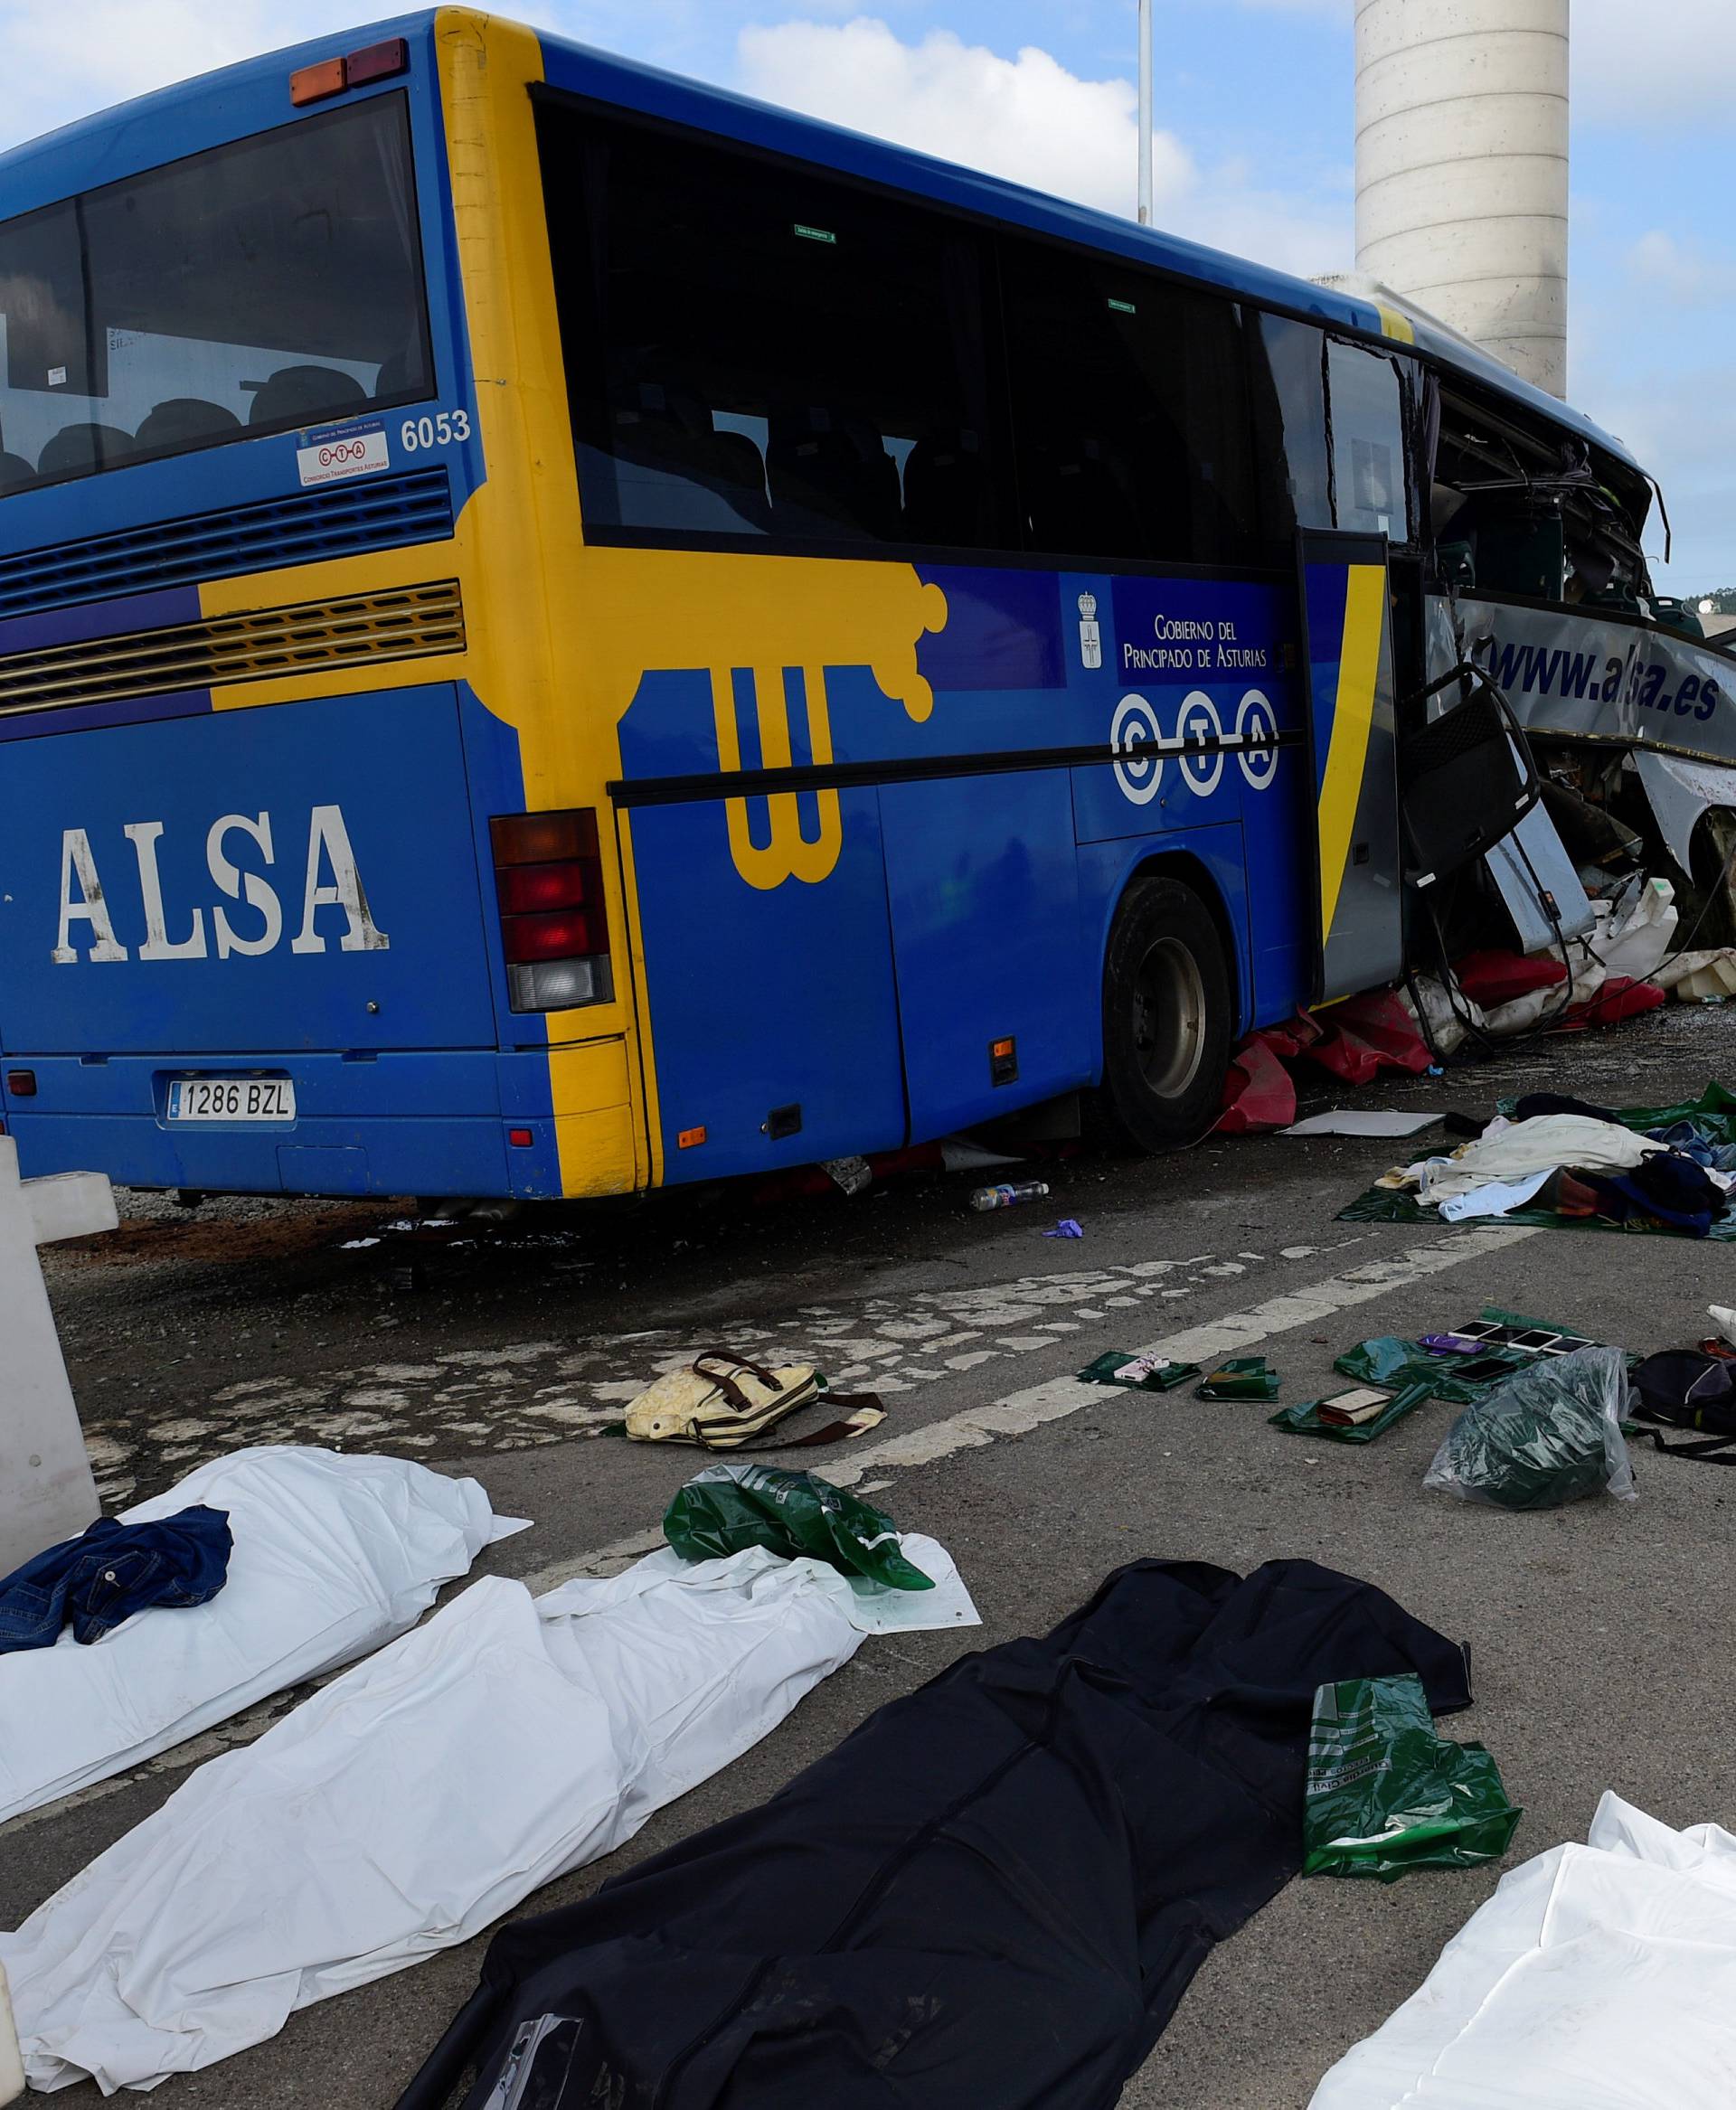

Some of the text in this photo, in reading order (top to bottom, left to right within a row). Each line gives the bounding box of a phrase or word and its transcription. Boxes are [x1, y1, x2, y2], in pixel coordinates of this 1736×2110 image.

[401, 410, 470, 452] 6053
[1154, 615, 1238, 641] GOBIERNO DEL
[1123, 643, 1267, 669] PRINCIPADO DE ASTURIAS
[1488, 642, 1719, 721] www.alsa.es
[51, 804, 391, 965] ALSA
[188, 1085, 240, 1115] 1286
[247, 1085, 289, 1115] BZL
[1313, 1779, 1341, 1792] Civil
